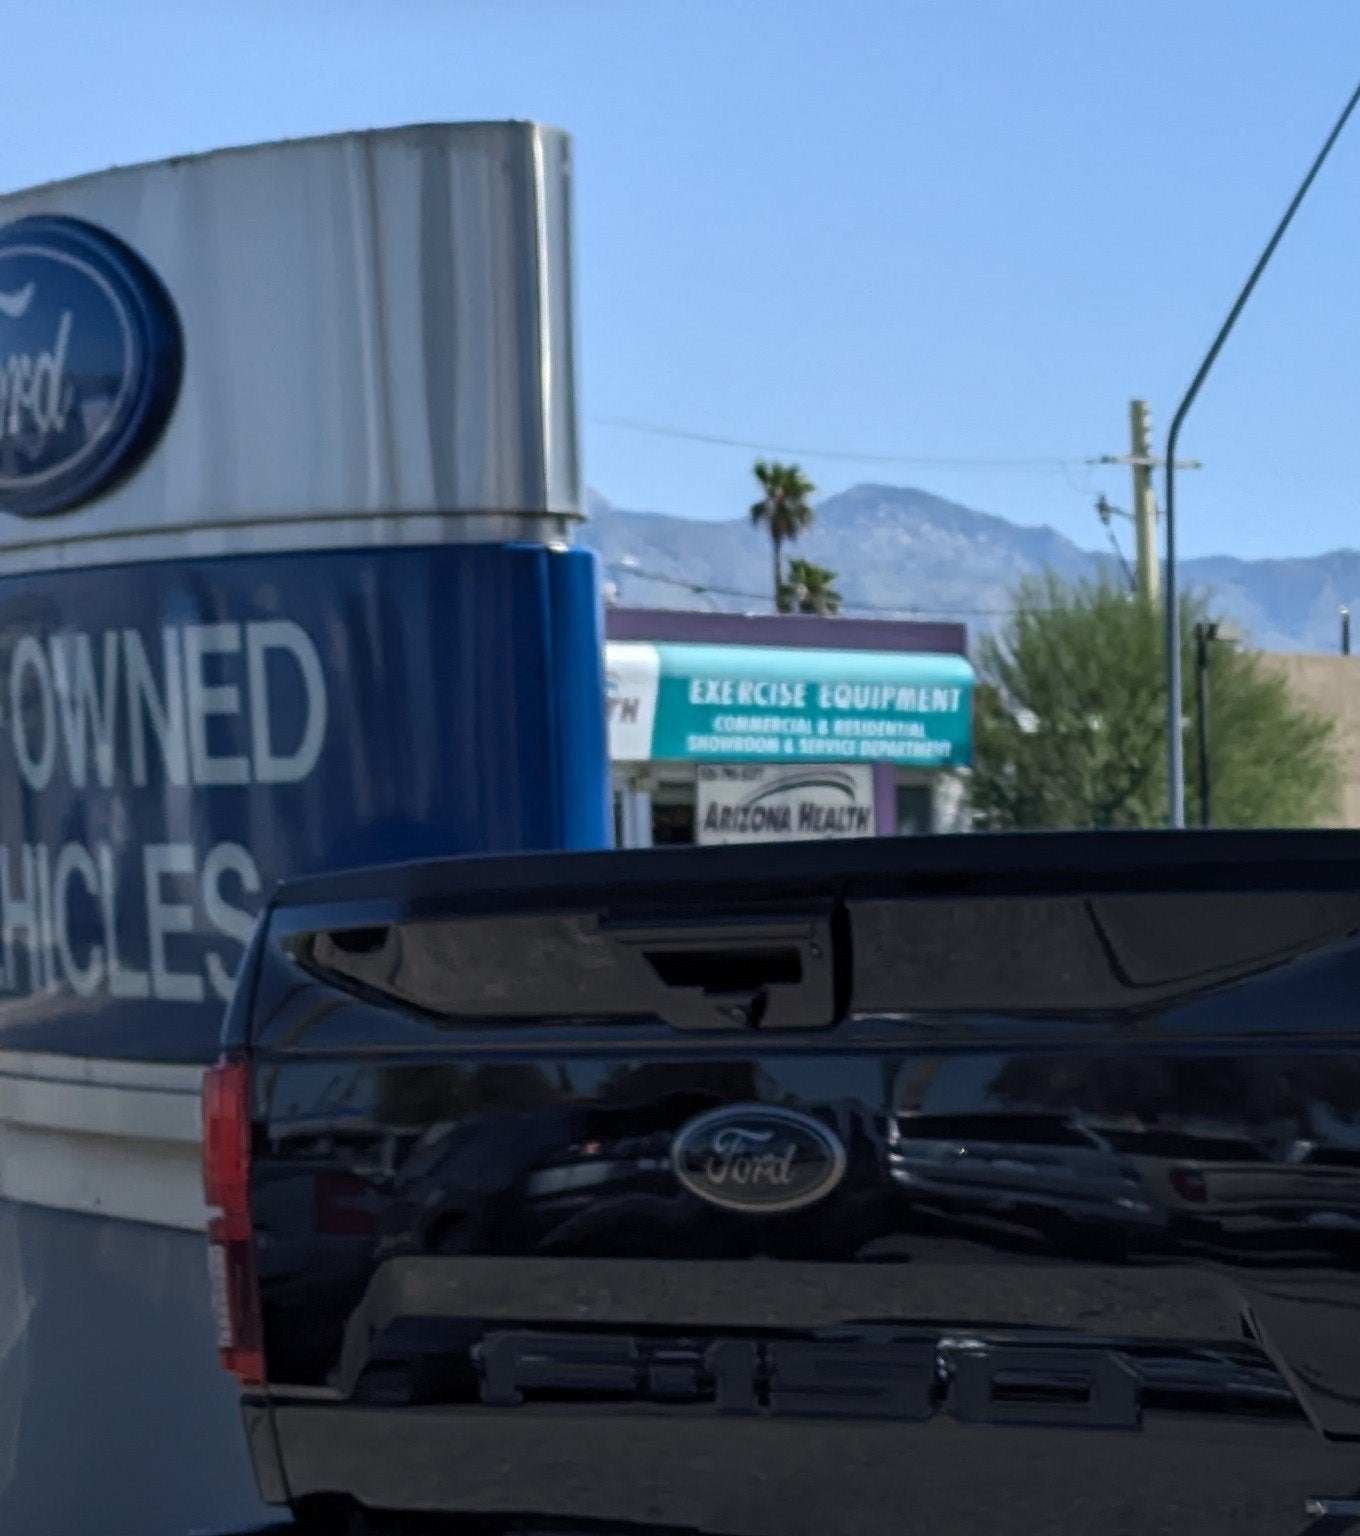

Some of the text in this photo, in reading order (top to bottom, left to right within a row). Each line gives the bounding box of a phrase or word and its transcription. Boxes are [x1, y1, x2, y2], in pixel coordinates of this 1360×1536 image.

[688, 678, 962, 714] EXERCISE EQUIPMENT
[712, 715, 812, 735] COMMERCIAL
[834, 718, 926, 739] RESIDENTIAL
[686, 734, 780, 754] SHOWROOM
[799, 738, 856, 756] SERVICE
[860, 739, 952, 758] DEPARTMENT
[704, 801, 871, 833] ARIZONA HEALTH
[0, 841, 263, 1000] HICLES
[704, 1127, 798, 1185] Ford
